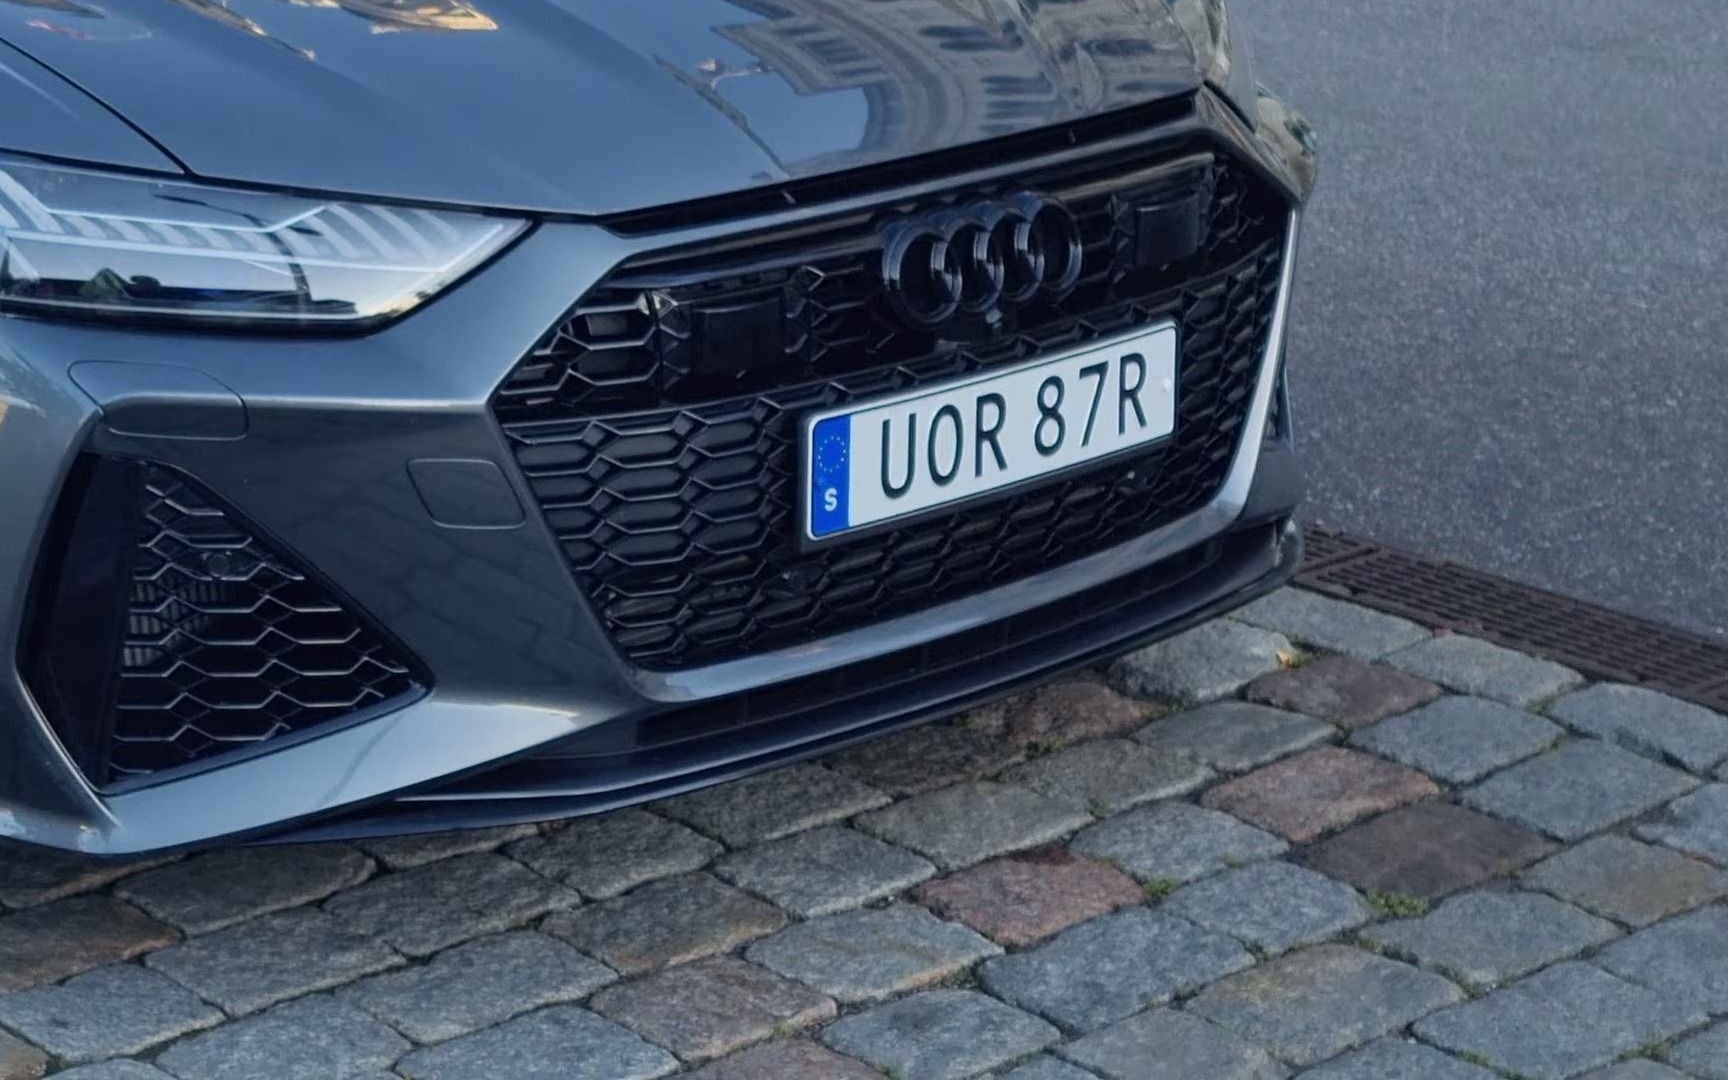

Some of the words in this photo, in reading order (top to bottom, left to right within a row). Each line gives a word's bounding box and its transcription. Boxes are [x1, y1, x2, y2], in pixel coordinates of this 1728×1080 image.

[880, 391, 1008, 500] UOR
[1033, 352, 1149, 458] 87R
[823, 487, 838, 513] S
